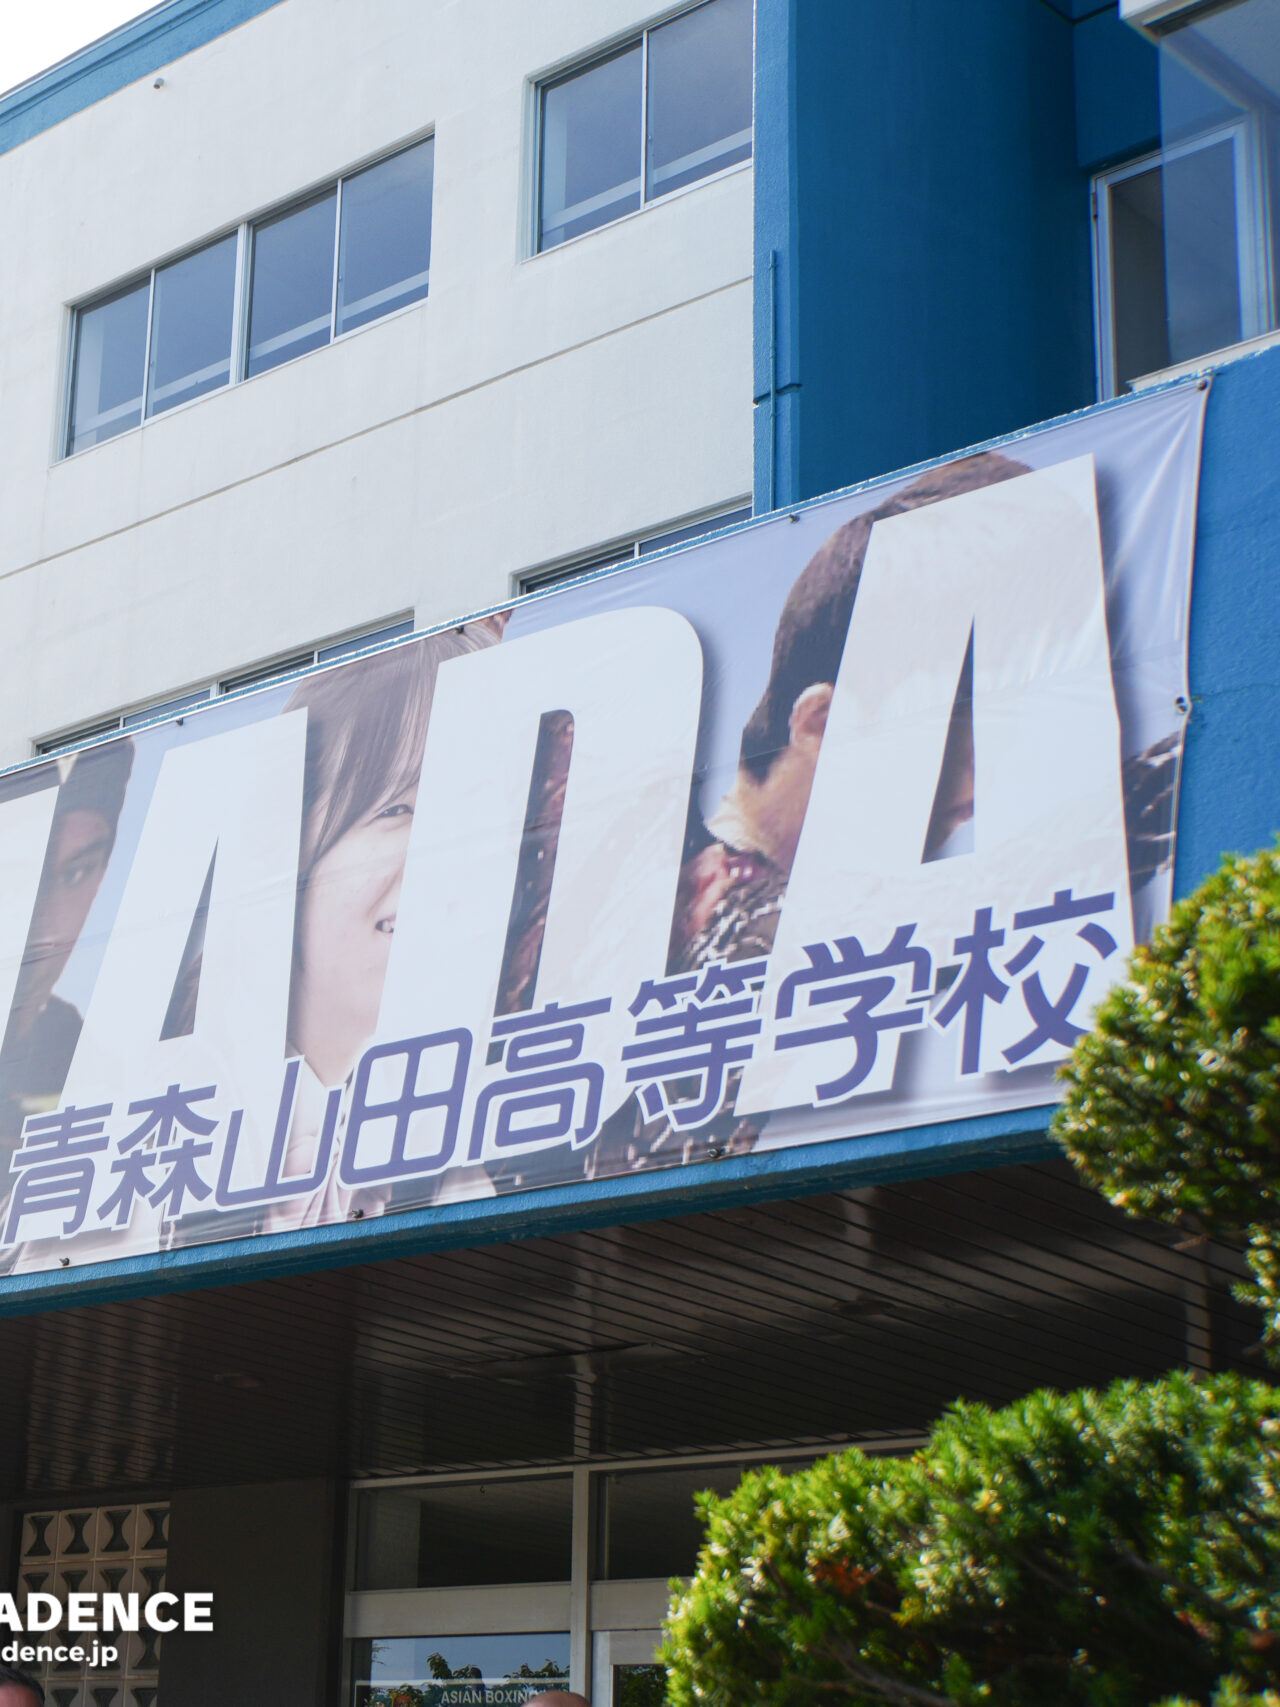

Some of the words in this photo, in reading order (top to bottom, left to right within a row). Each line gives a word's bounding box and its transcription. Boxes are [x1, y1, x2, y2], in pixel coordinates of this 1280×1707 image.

[2, 888, 1116, 1245] 青森山田高等学校
[441, 1690, 482, 1704] ASIAN
[485, 1689, 533, 1704] BOXIN
